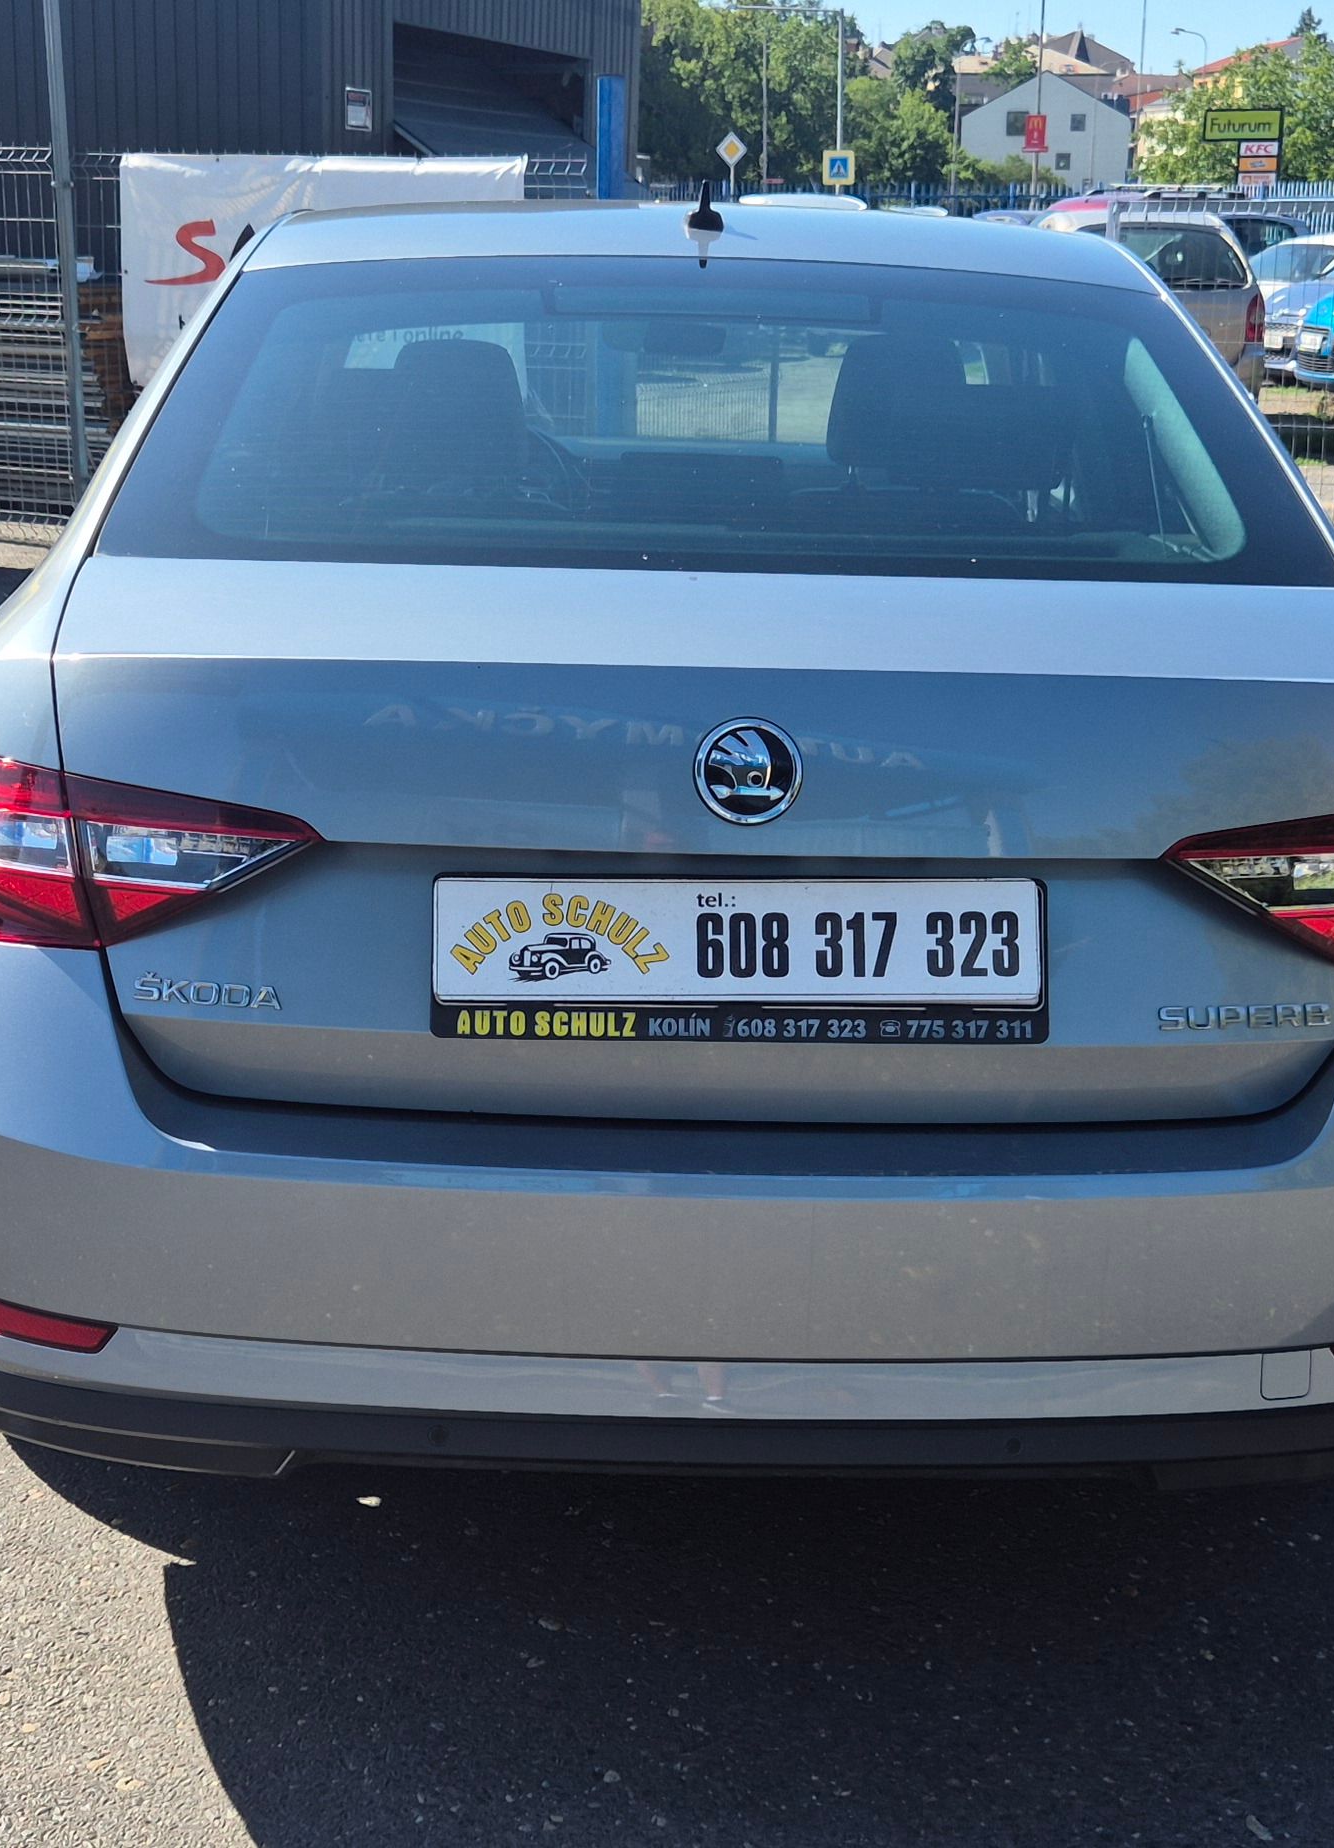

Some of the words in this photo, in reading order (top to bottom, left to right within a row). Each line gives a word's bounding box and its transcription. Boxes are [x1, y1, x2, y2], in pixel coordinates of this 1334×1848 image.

[1210, 118, 1272, 133] Futurum
[1244, 144, 1274, 154] KFC
[696, 892, 736, 908] tel.:
[450, 900, 531, 975] AUTO
[542, 893, 670, 975] SCHULZ
[696, 912, 789, 978] 608
[815, 912, 897, 978] 317
[926, 911, 1019, 977] 323
[133, 971, 283, 1010] ŠKODA
[456, 1010, 526, 1036] AUTO
[534, 1011, 636, 1037] SCHULZ
[648, 1012, 711, 1037] KOLÍN
[738, 1018, 776, 1038] 608
[783, 1018, 820, 1038] 317
[827, 1018, 866, 1039] 323
[906, 1019, 944, 1039] 775
[951, 1019, 989, 1039] 317
[996, 1019, 1033, 1039] 311
[1158, 1003, 1331, 1031] SUPERB
